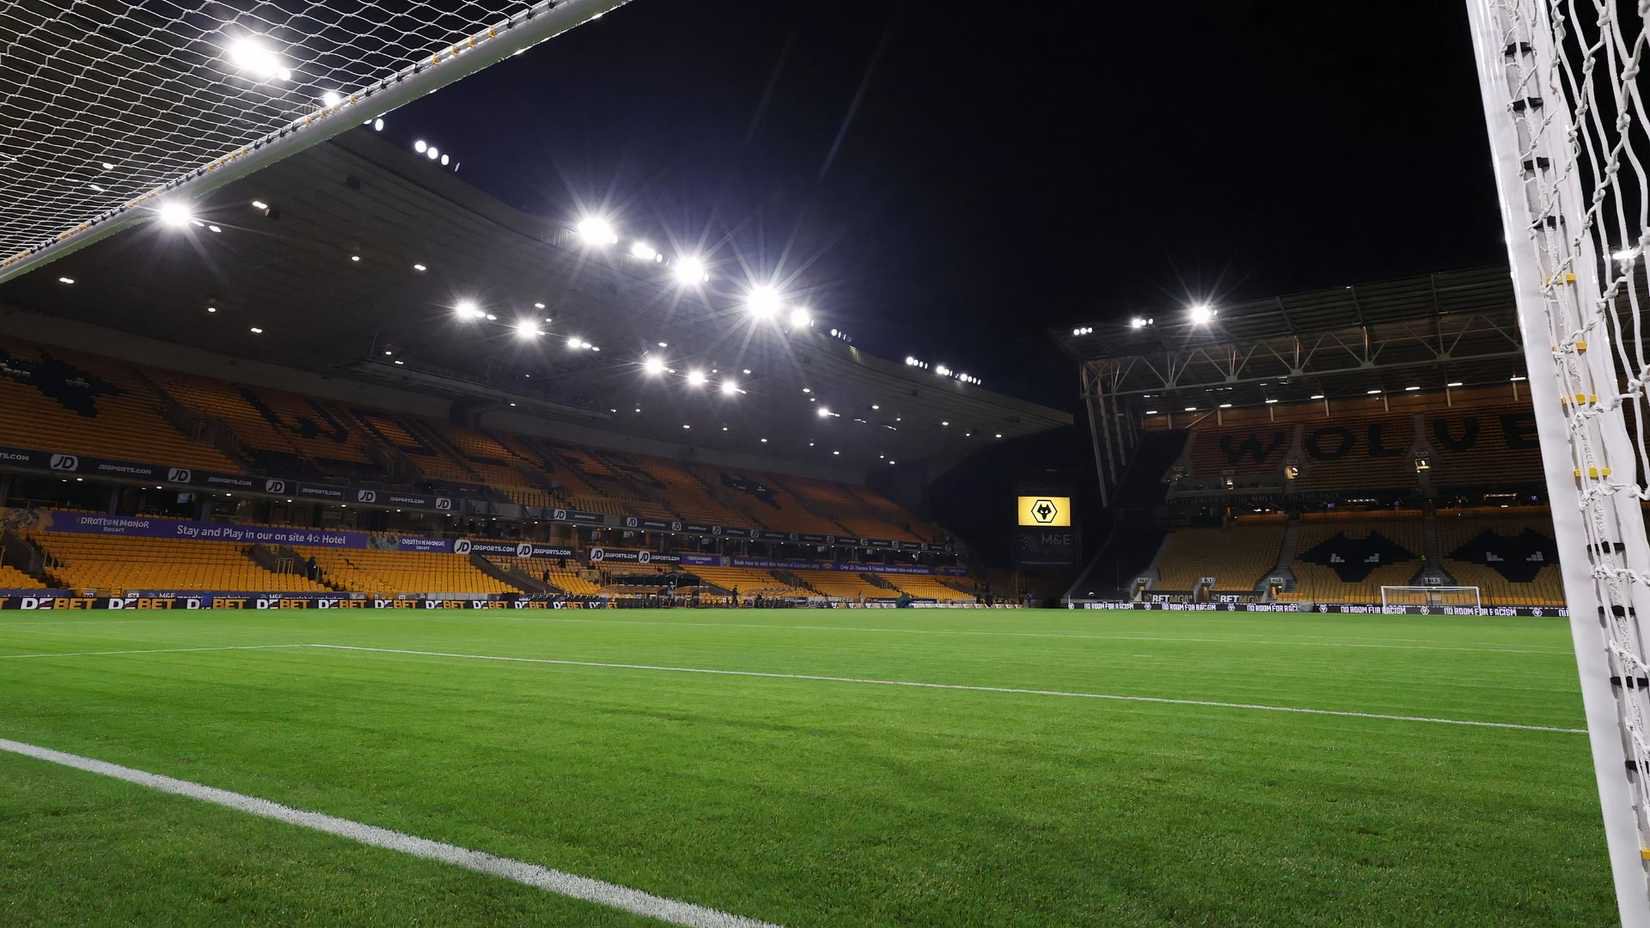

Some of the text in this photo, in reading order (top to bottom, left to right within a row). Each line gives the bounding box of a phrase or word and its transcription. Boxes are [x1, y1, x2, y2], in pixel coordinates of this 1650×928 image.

[51, 454, 78, 470] JD
[169, 468, 190, 483] JD
[266, 480, 285, 493] JD
[359, 490, 375, 502] JD
[436, 498, 451, 510] JD
[176, 524, 199, 537] Stay
[201, 527, 221, 537] and
[223, 527, 243, 540] Play
[245, 529, 254, 538] in
[257, 532, 272, 540] our
[275, 533, 286, 541] on
[288, 532, 304, 542] site
[322, 535, 346, 545] Hotel
[454, 540, 471, 554] JD
[472, 544, 515, 553] JDSPORTS.COM
[517, 544, 532, 557] JD
[591, 549, 604, 561] JD
[639, 551, 650, 562] JD
[187, 598, 248, 610] DBET
[1454, 607, 1474, 615] ROOM
